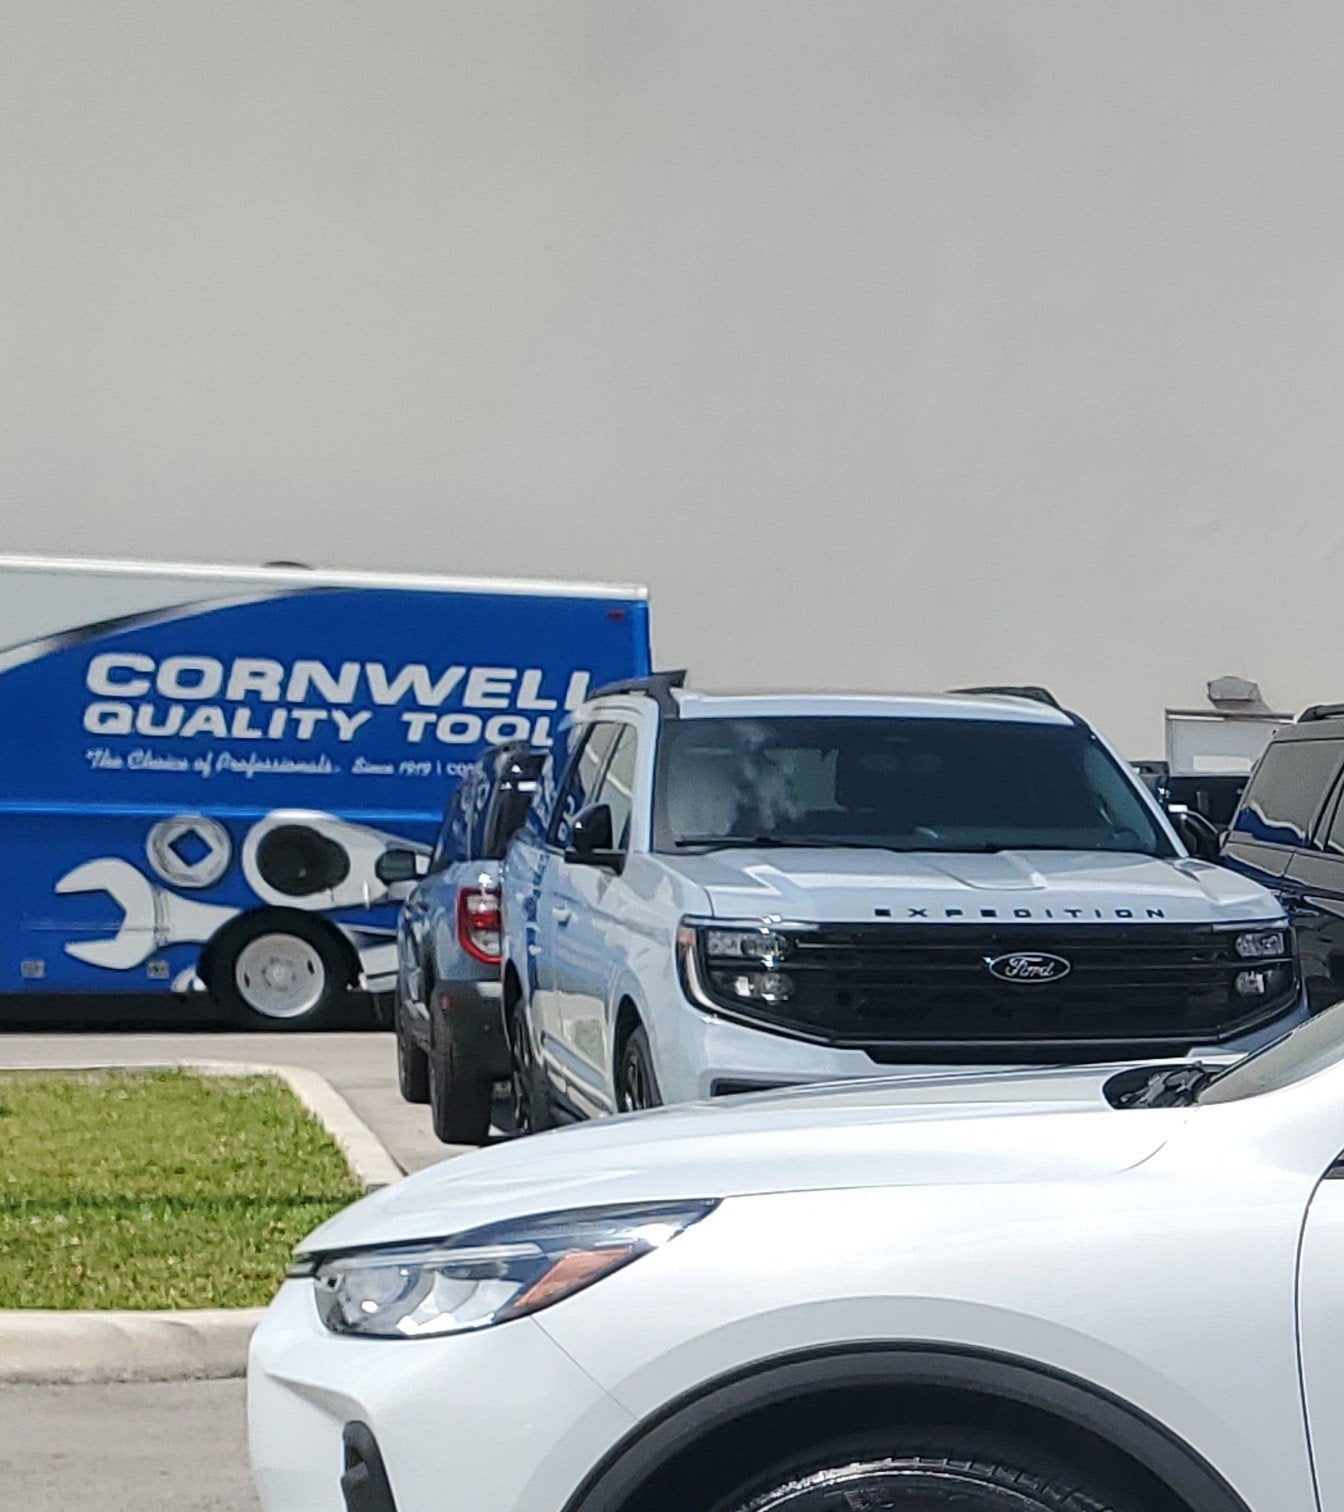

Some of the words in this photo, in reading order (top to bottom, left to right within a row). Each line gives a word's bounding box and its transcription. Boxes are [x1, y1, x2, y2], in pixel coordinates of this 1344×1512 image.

[86, 652, 591, 710] CORNWELL
[83, 702, 373, 741] QUALITY
[401, 711, 555, 748] TOOL
[193, 750, 213, 779] of
[874, 908, 1165, 919] EXPEDITION
